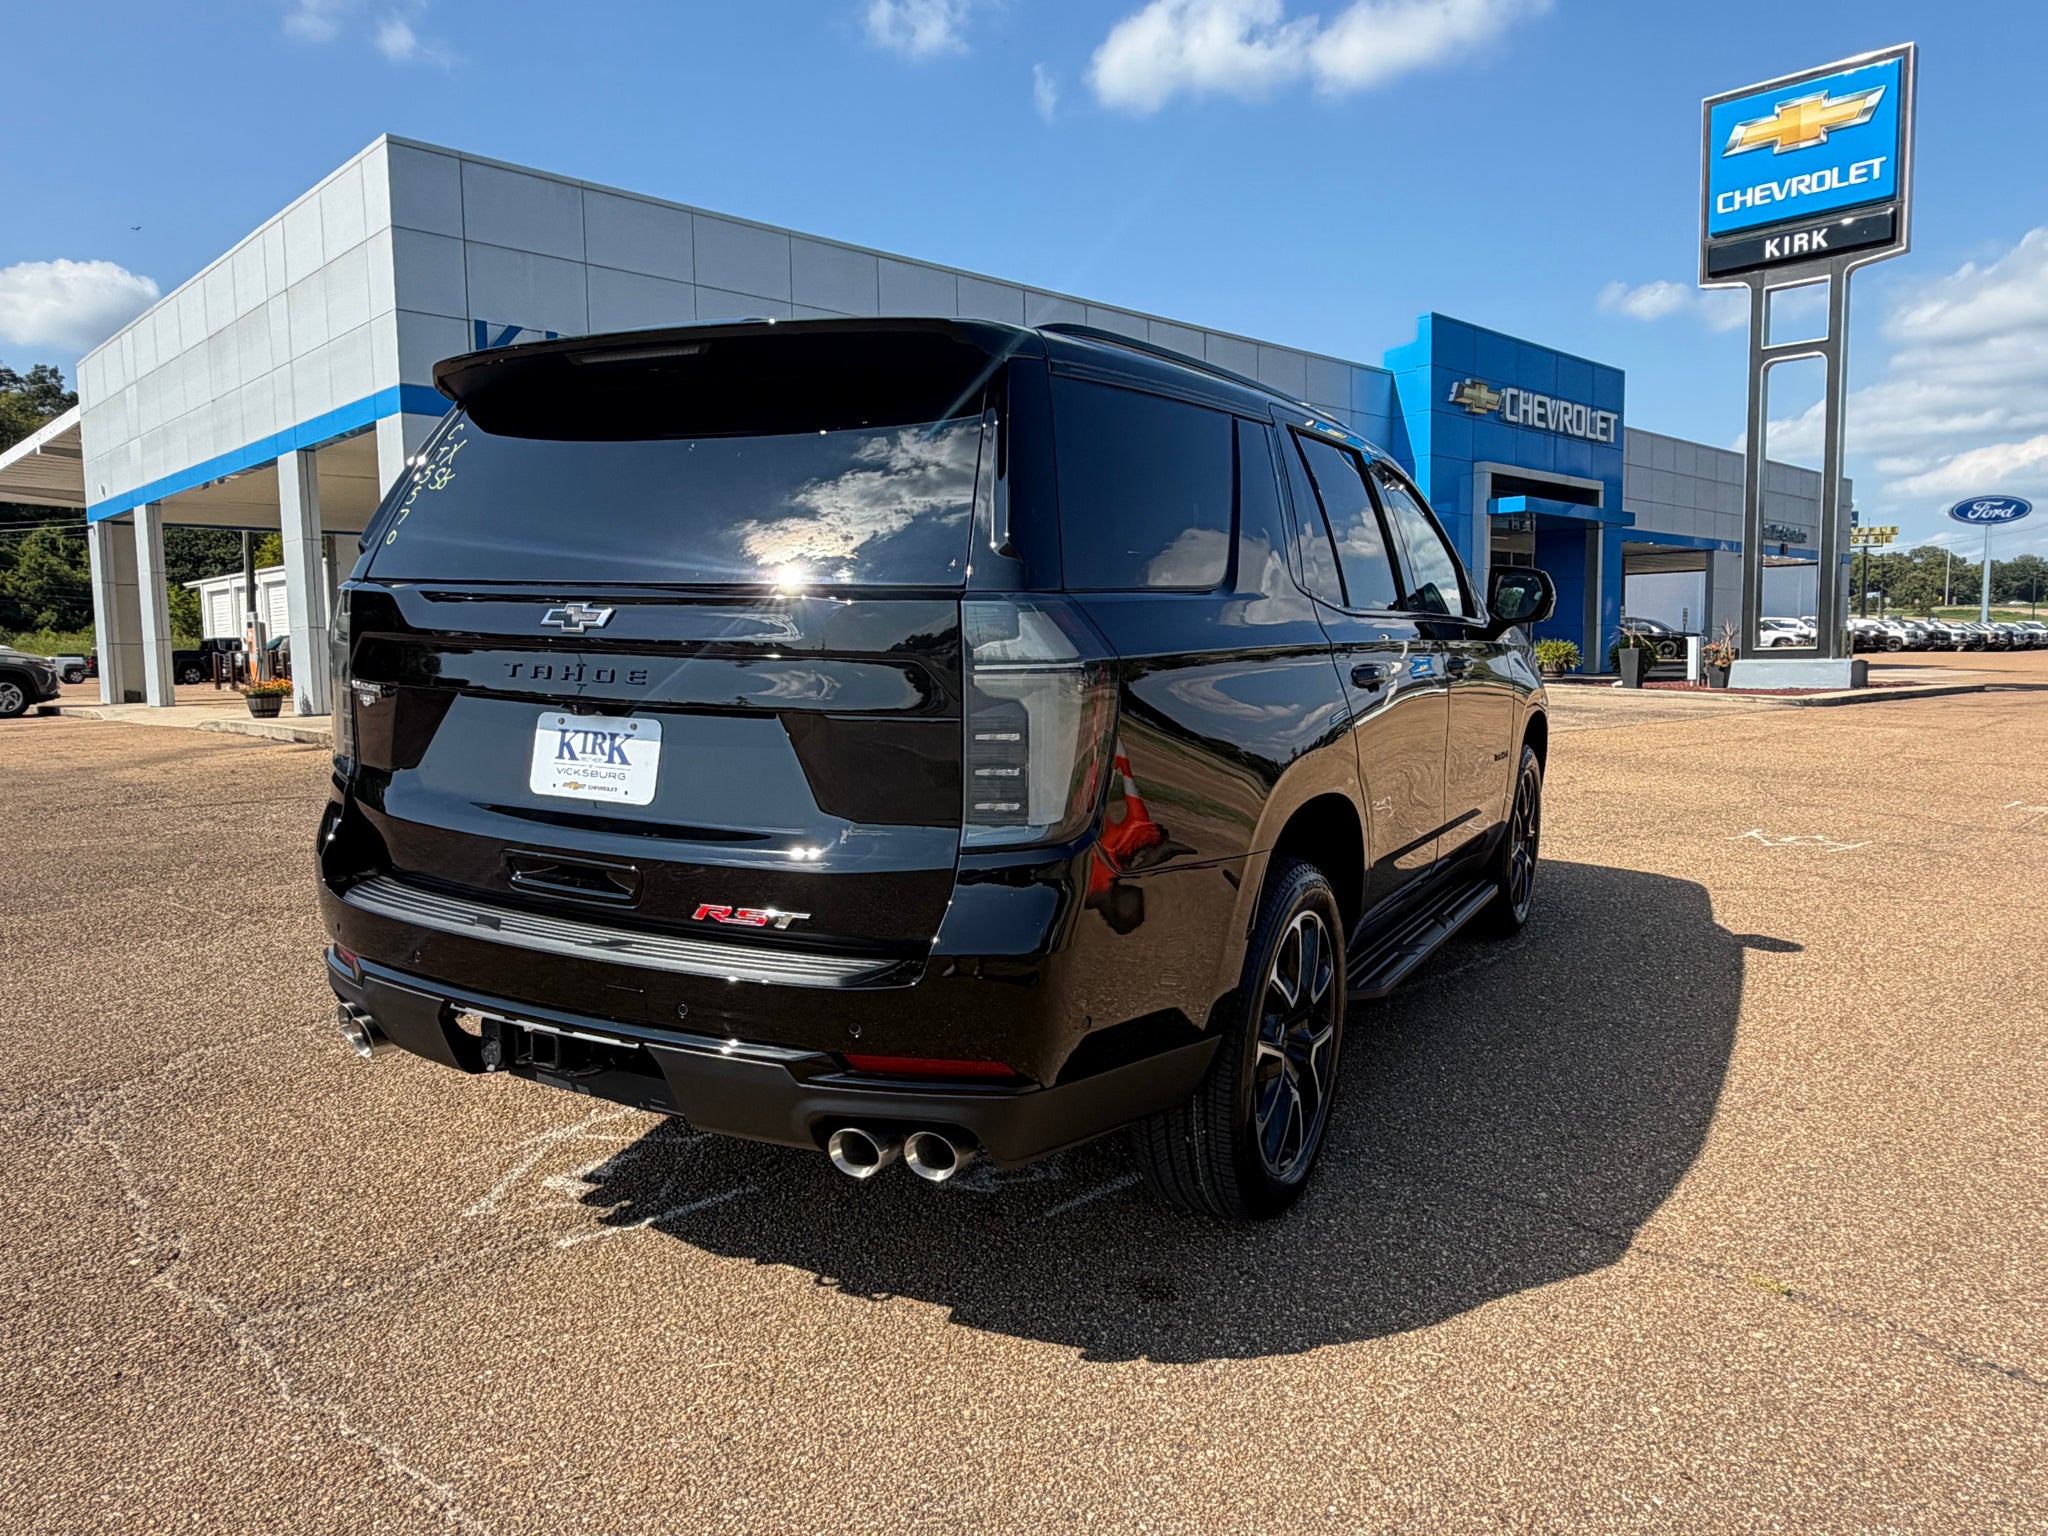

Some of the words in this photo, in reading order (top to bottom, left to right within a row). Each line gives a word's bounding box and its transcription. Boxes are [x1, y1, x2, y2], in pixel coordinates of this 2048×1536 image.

[1716, 156, 1887, 214] CHEVROLET
[1764, 228, 1829, 259] KIRK
[1501, 387, 1619, 444] CHEVROLET
[1967, 500, 2017, 519] Ford
[503, 662, 648, 686] TAHOE
[554, 728, 635, 766] KIRK
[556, 766, 627, 781] VICKSBURG
[691, 903, 811, 930] RST
